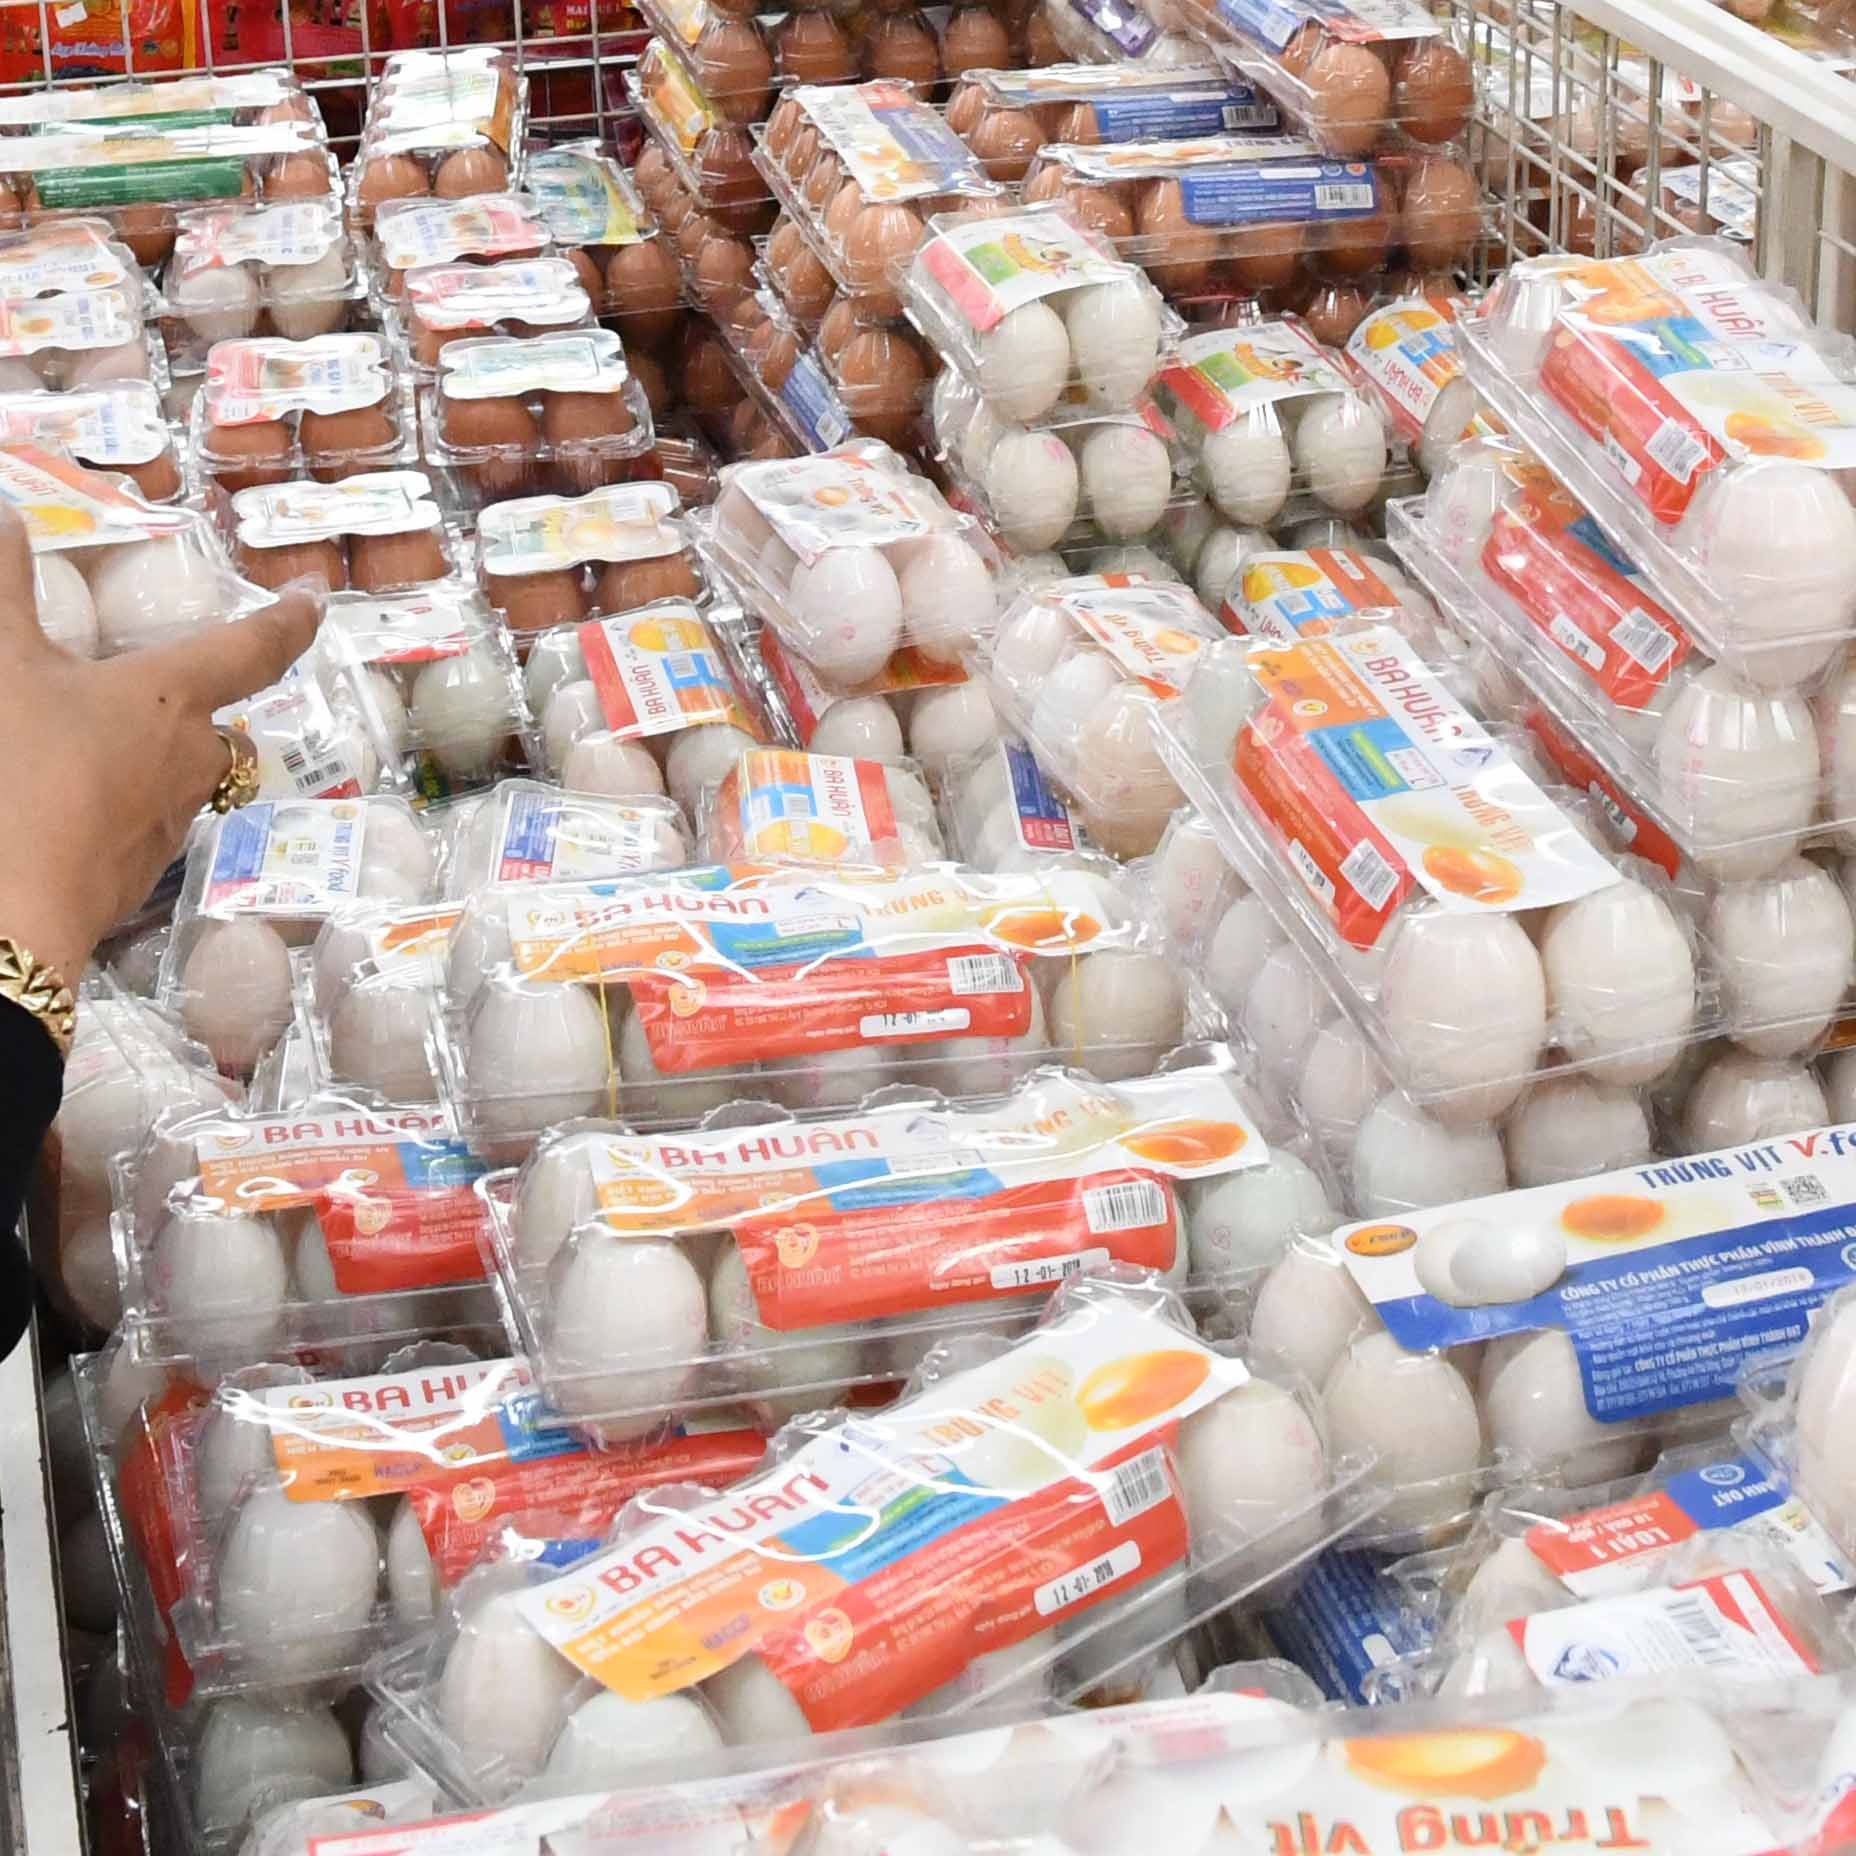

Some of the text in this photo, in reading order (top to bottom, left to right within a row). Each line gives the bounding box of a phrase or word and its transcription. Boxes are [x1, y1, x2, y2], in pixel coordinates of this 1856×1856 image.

[736, 1126, 881, 1165] HUÂN
[1637, 1157, 1732, 1191] TRỨNG
[1741, 1143, 1786, 1175] VỊT
[598, 1544, 681, 1595] BA
